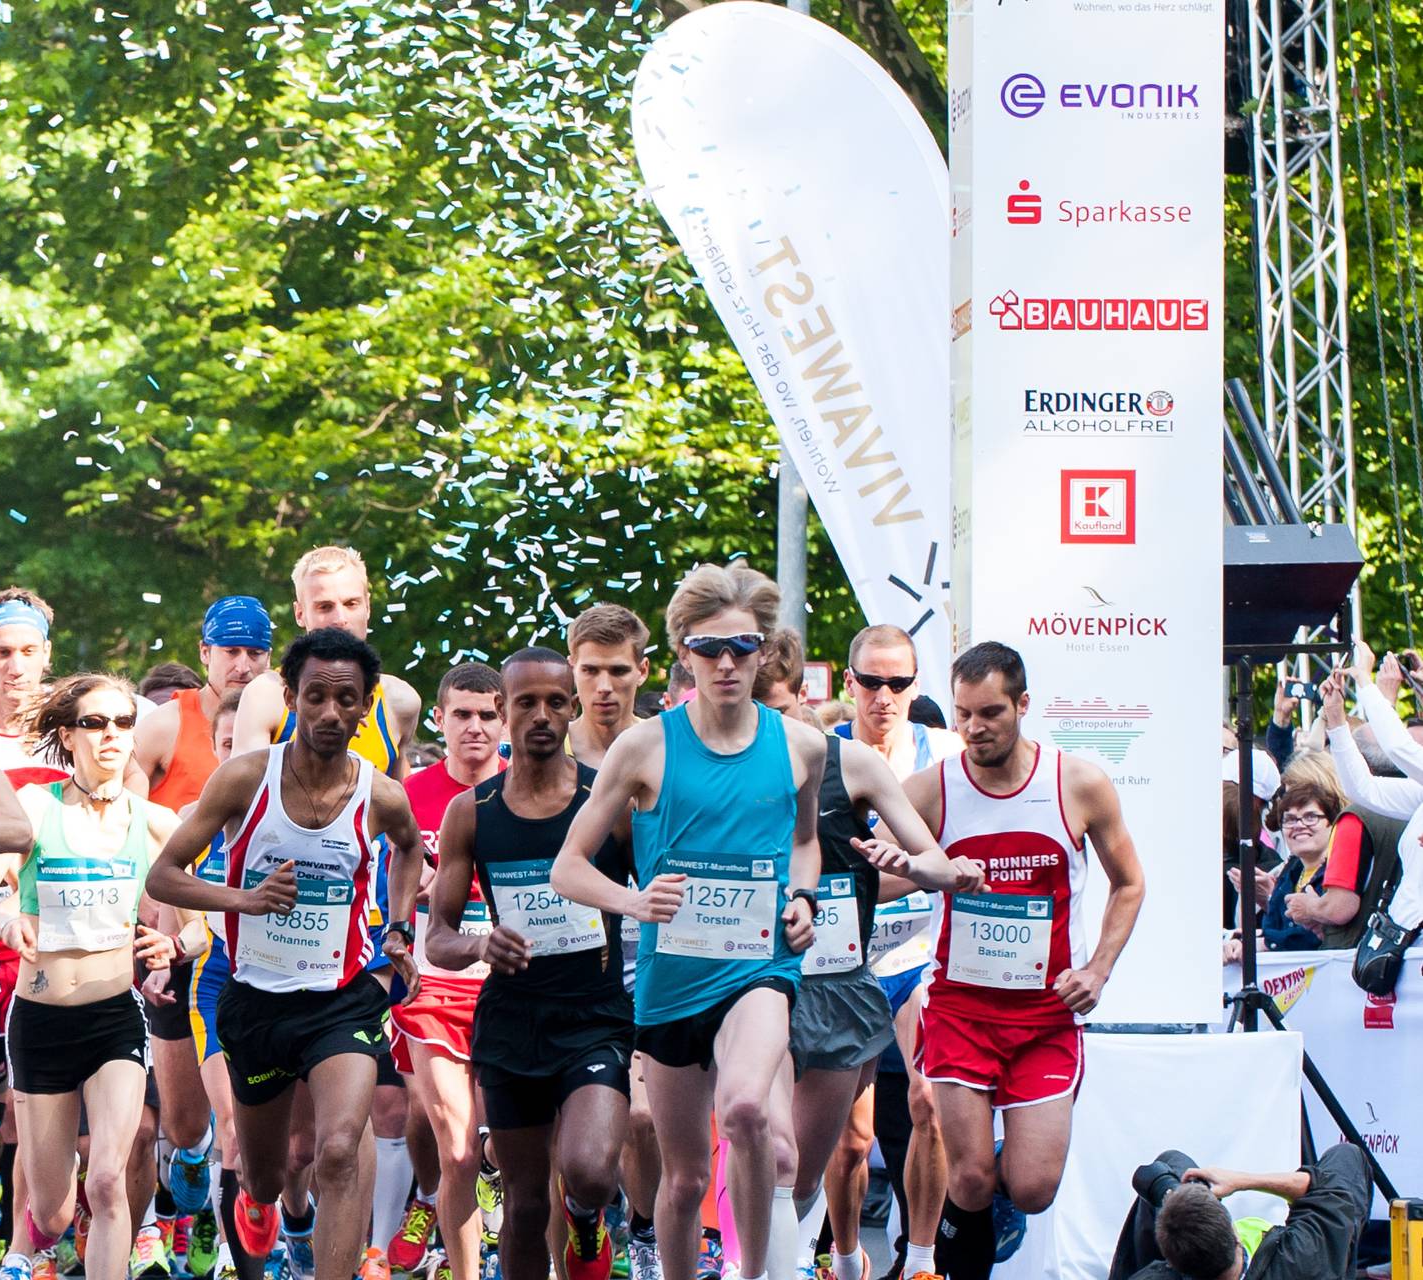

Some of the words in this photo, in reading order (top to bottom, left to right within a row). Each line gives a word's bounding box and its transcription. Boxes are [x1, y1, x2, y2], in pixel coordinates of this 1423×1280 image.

[1073, 2, 1115, 14] Wohnen,
[1119, 4, 1132, 12] wo
[1134, 2, 1151, 12] das
[1154, 2, 1175, 12] Herz
[1060, 83, 1199, 109] EVONIK
[1121, 112, 1200, 120] INDUSTRIES
[1058, 199, 1192, 227] Sparkasse
[1024, 300, 1208, 330] BAUHAUS
[1024, 390, 1144, 415] ERDINGER
[1024, 420, 1173, 432] ALKOHOLFREI
[1074, 521, 1122, 530] Kaufland
[1065, 642, 1095, 653] Hotel
[1099, 642, 1130, 653] Essen
[1060, 719, 1133, 731] metropoleruhr
[1127, 775, 1151, 786] Ruhr
[666, 859, 749, 872] VIVAWEST-Marathon
[989, 854, 1059, 870] RUNNERS
[990, 869, 1034, 881] POINT
[58, 888, 119, 907] 13213
[512, 890, 573, 912] 1254
[685, 885, 756, 909] 12577
[266, 909, 329, 931] 19855
[528, 914, 566, 926] Ahmed
[695, 913, 740, 925] Torsten
[266, 930, 320, 947] Yohannes
[570, 932, 600, 943] EVONIK
[970, 921, 1031, 944] 13000
[978, 946, 1017, 959] Bastian
[309, 962, 339, 970] EVONIK
[1263, 967, 1306, 997] DEXTRO
